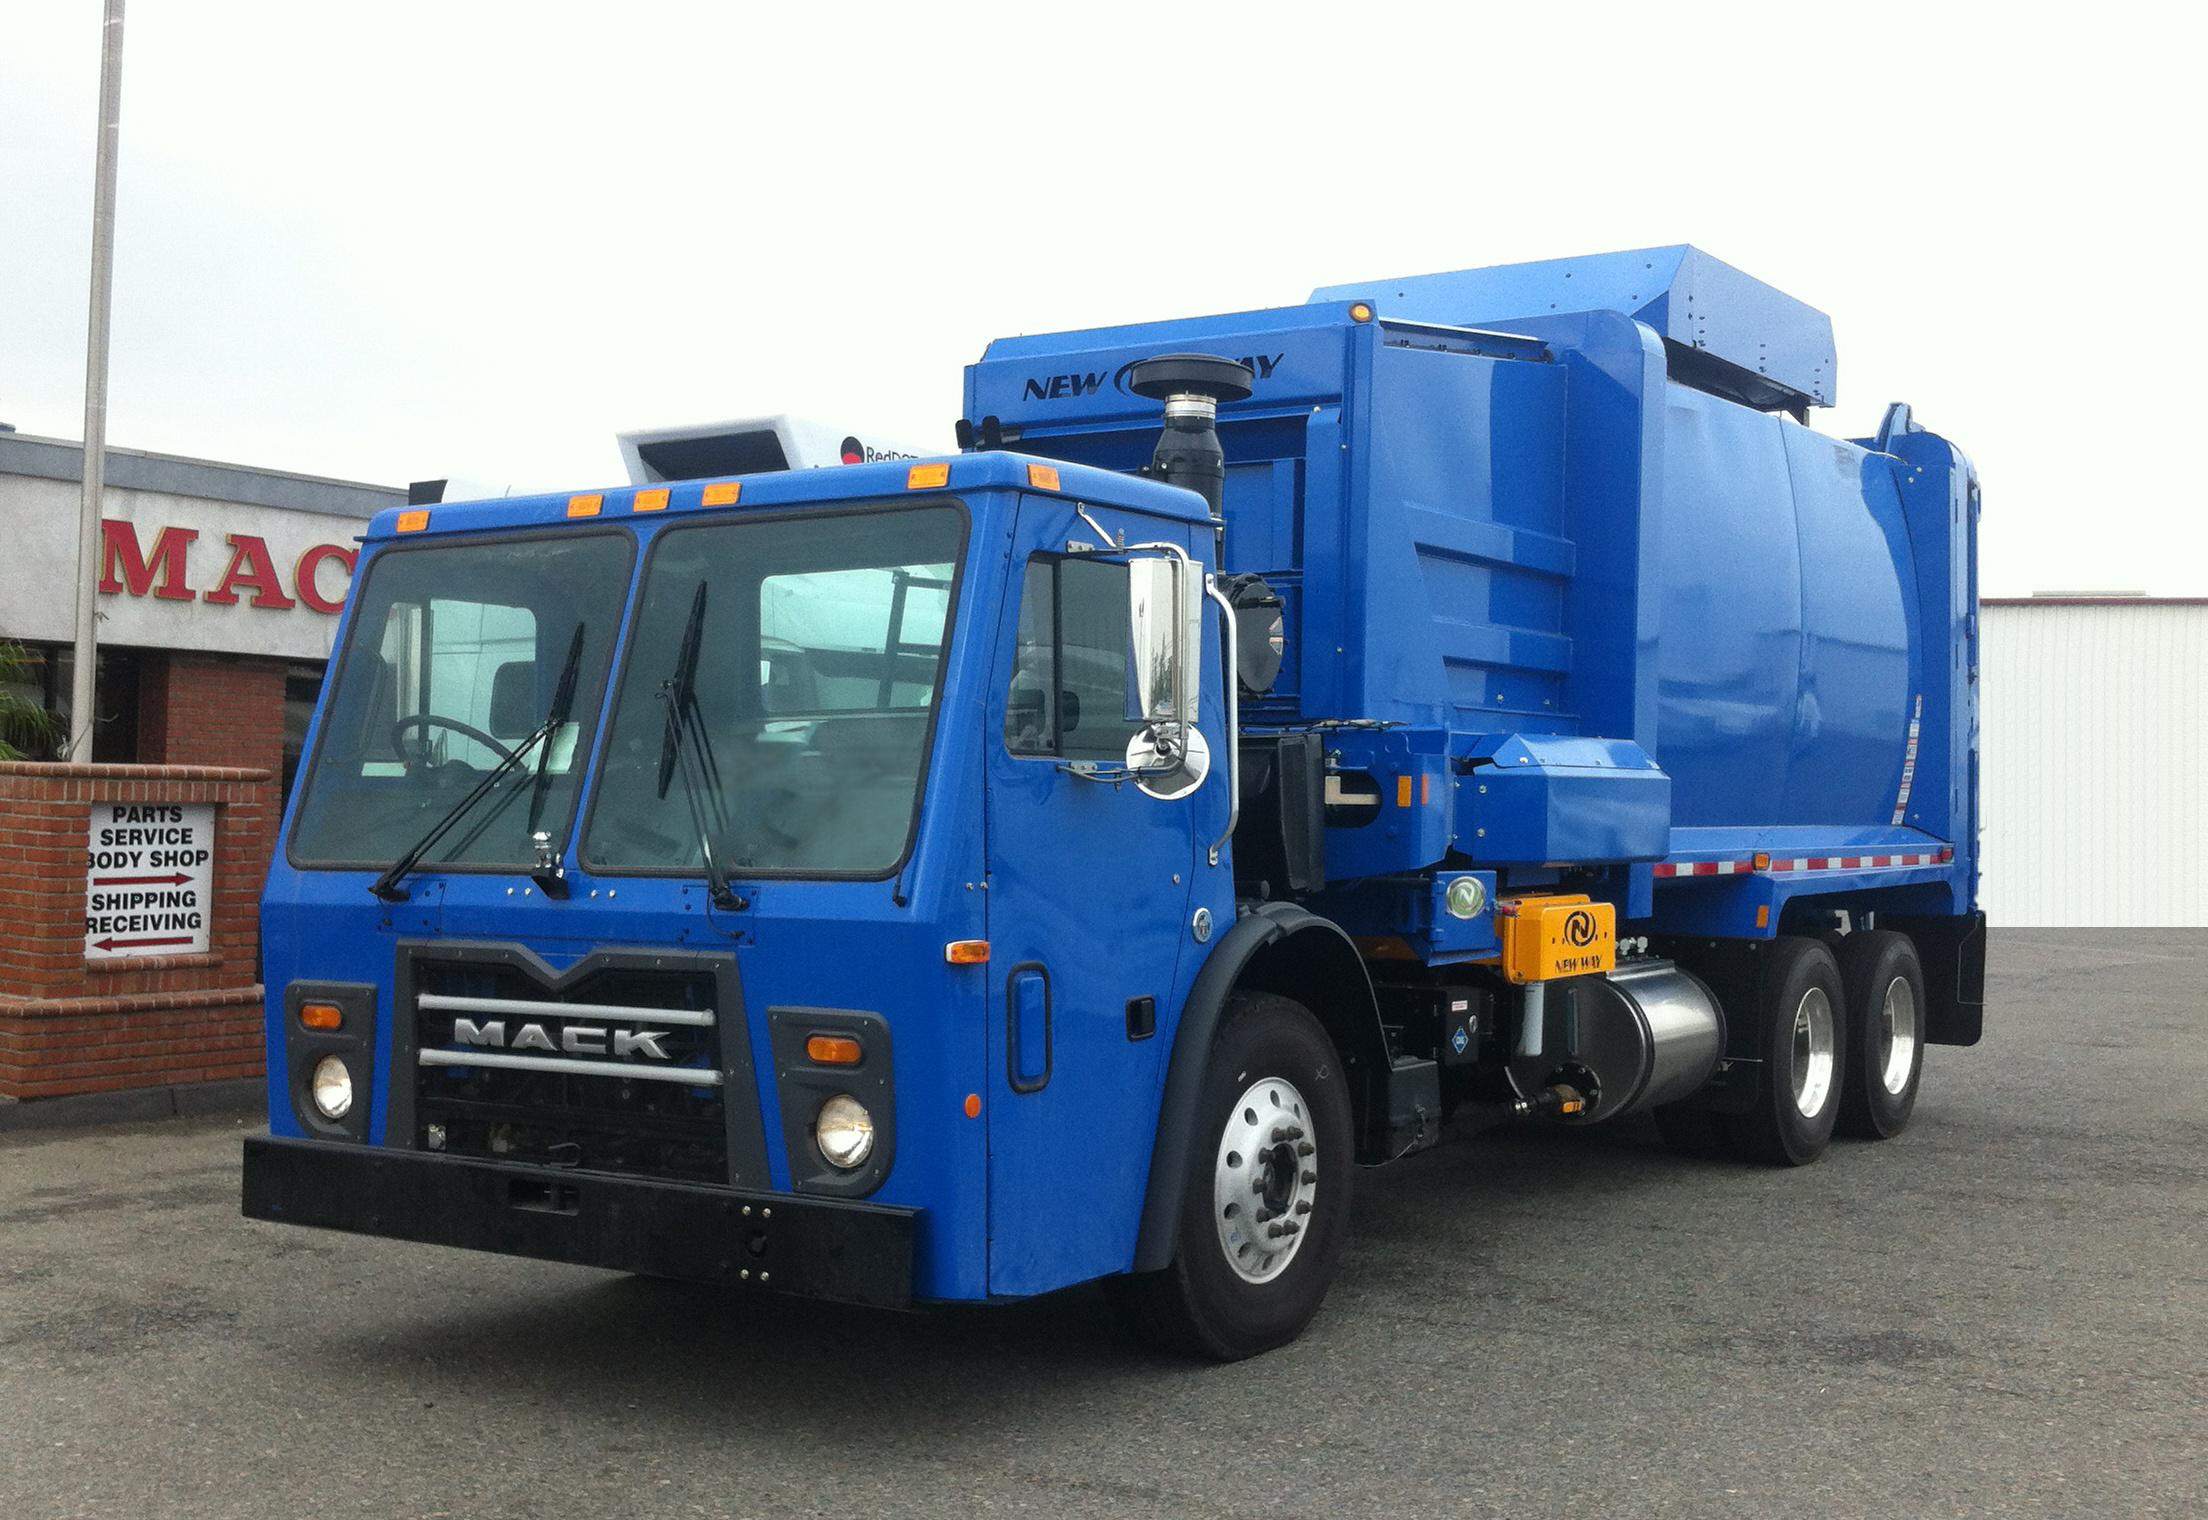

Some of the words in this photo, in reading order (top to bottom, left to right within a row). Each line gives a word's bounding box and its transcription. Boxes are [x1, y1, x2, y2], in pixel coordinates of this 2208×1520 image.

[1022, 370, 1108, 401] NEW
[112, 805, 183, 823] PARTS
[100, 828, 193, 846] SERVICE
[150, 850, 208, 867] SHOP
[91, 890, 197, 911] SHIPPING
[86, 912, 201, 934] RECEIVING
[1554, 958, 1579, 974] NEW
[454, 1018, 671, 1059] MACK
